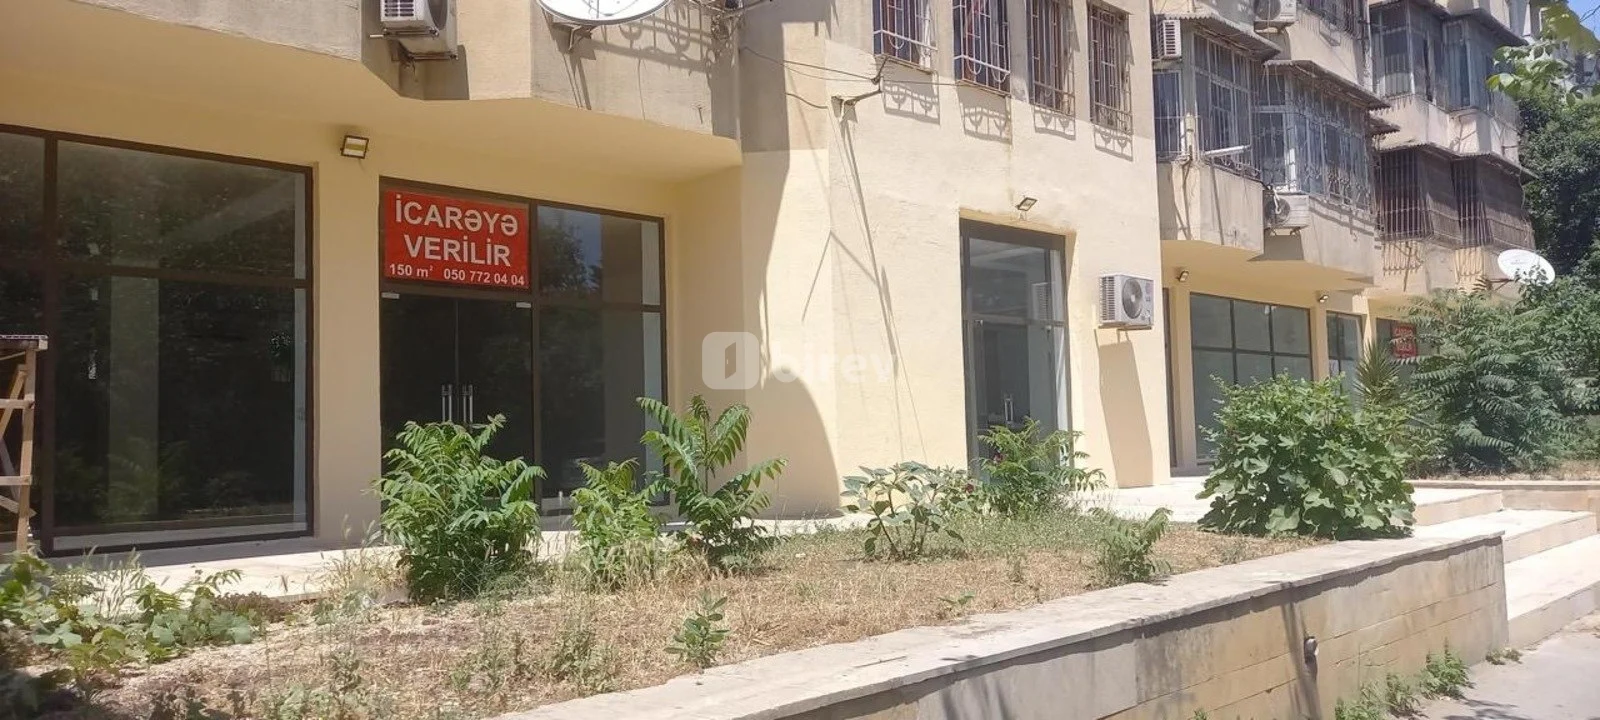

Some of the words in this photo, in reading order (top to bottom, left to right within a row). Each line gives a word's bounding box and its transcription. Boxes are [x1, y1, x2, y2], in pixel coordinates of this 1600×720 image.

[396, 194, 518, 236] İCARƏYƏ
[404, 234, 511, 267] VERİLİR
[390, 264, 413, 276] 150
[443, 268, 466, 281] 050
[470, 270, 491, 283] 772
[494, 273, 508, 285] 04
[510, 274, 525, 286] 04
